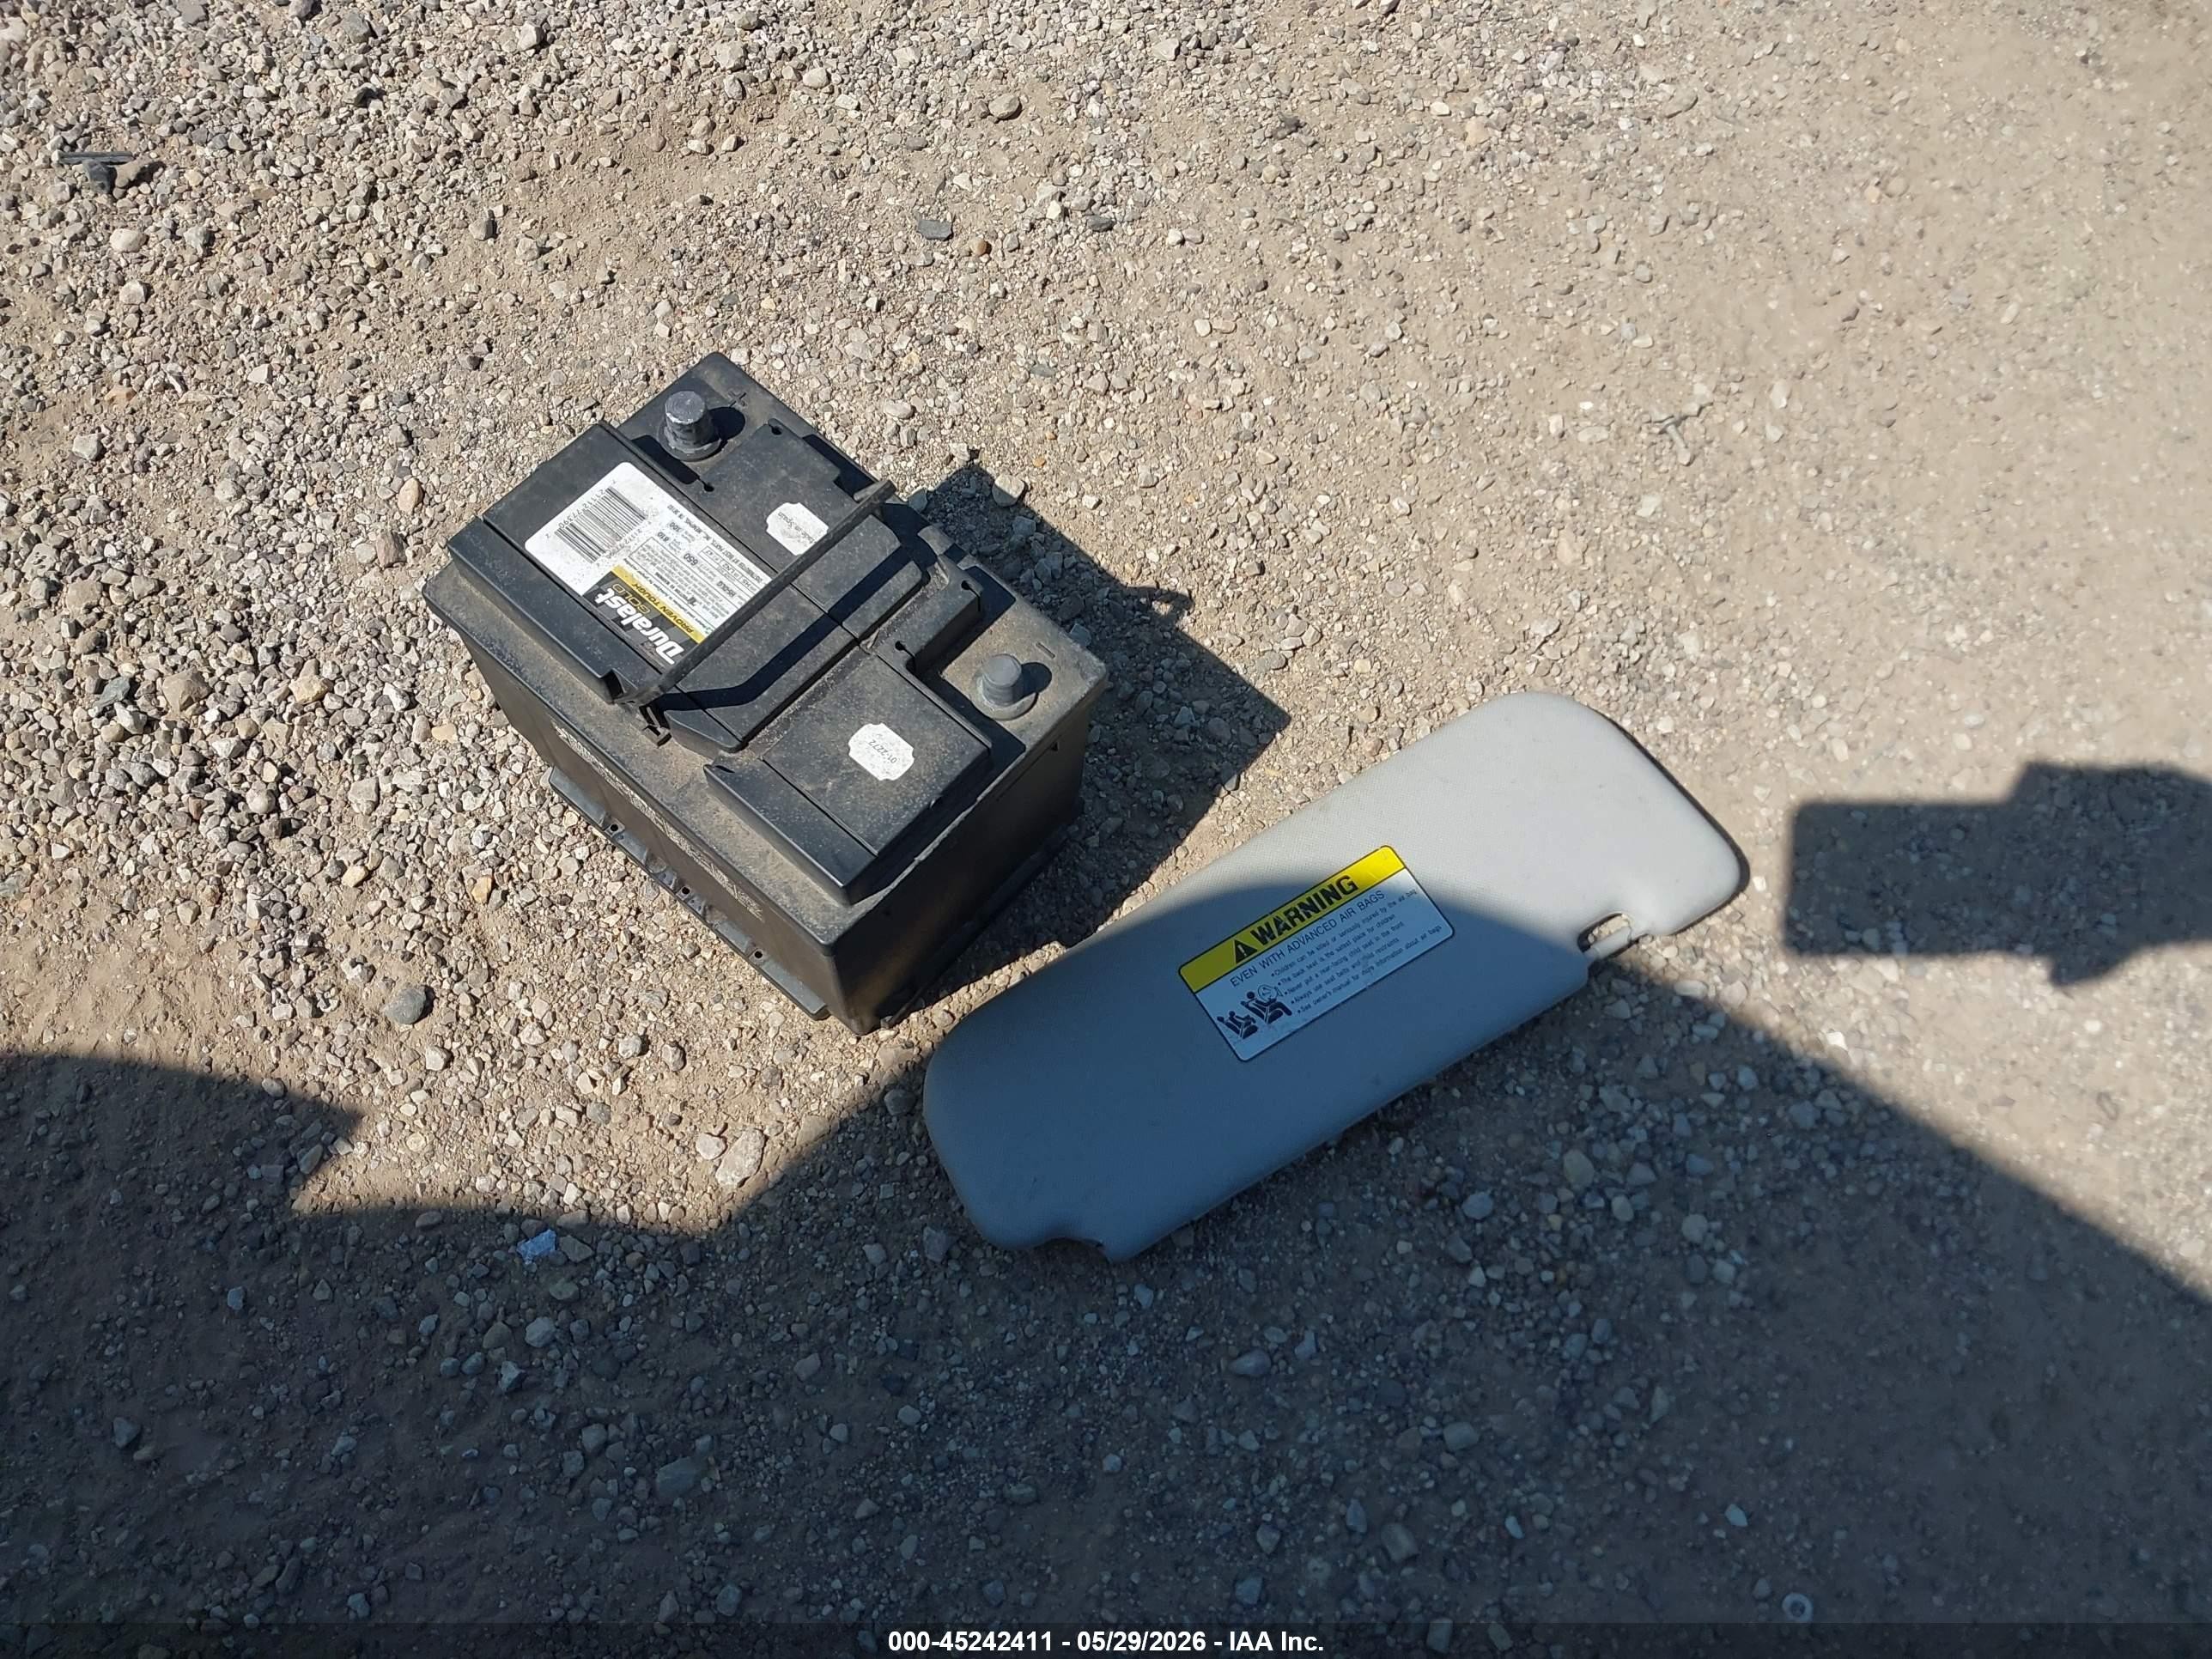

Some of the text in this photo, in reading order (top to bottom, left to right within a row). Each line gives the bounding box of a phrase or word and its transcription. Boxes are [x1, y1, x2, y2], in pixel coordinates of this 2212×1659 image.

[682, 551, 698, 567] 650
[593, 586, 684, 665] Duralast
[611, 582, 651, 613] GOLD
[633, 583, 694, 633] PROVEN TOUGH
[1229, 889, 1385, 987] EVEN WITH ADVANCED AIR BAGS
[1249, 872, 1358, 945] WARNING
